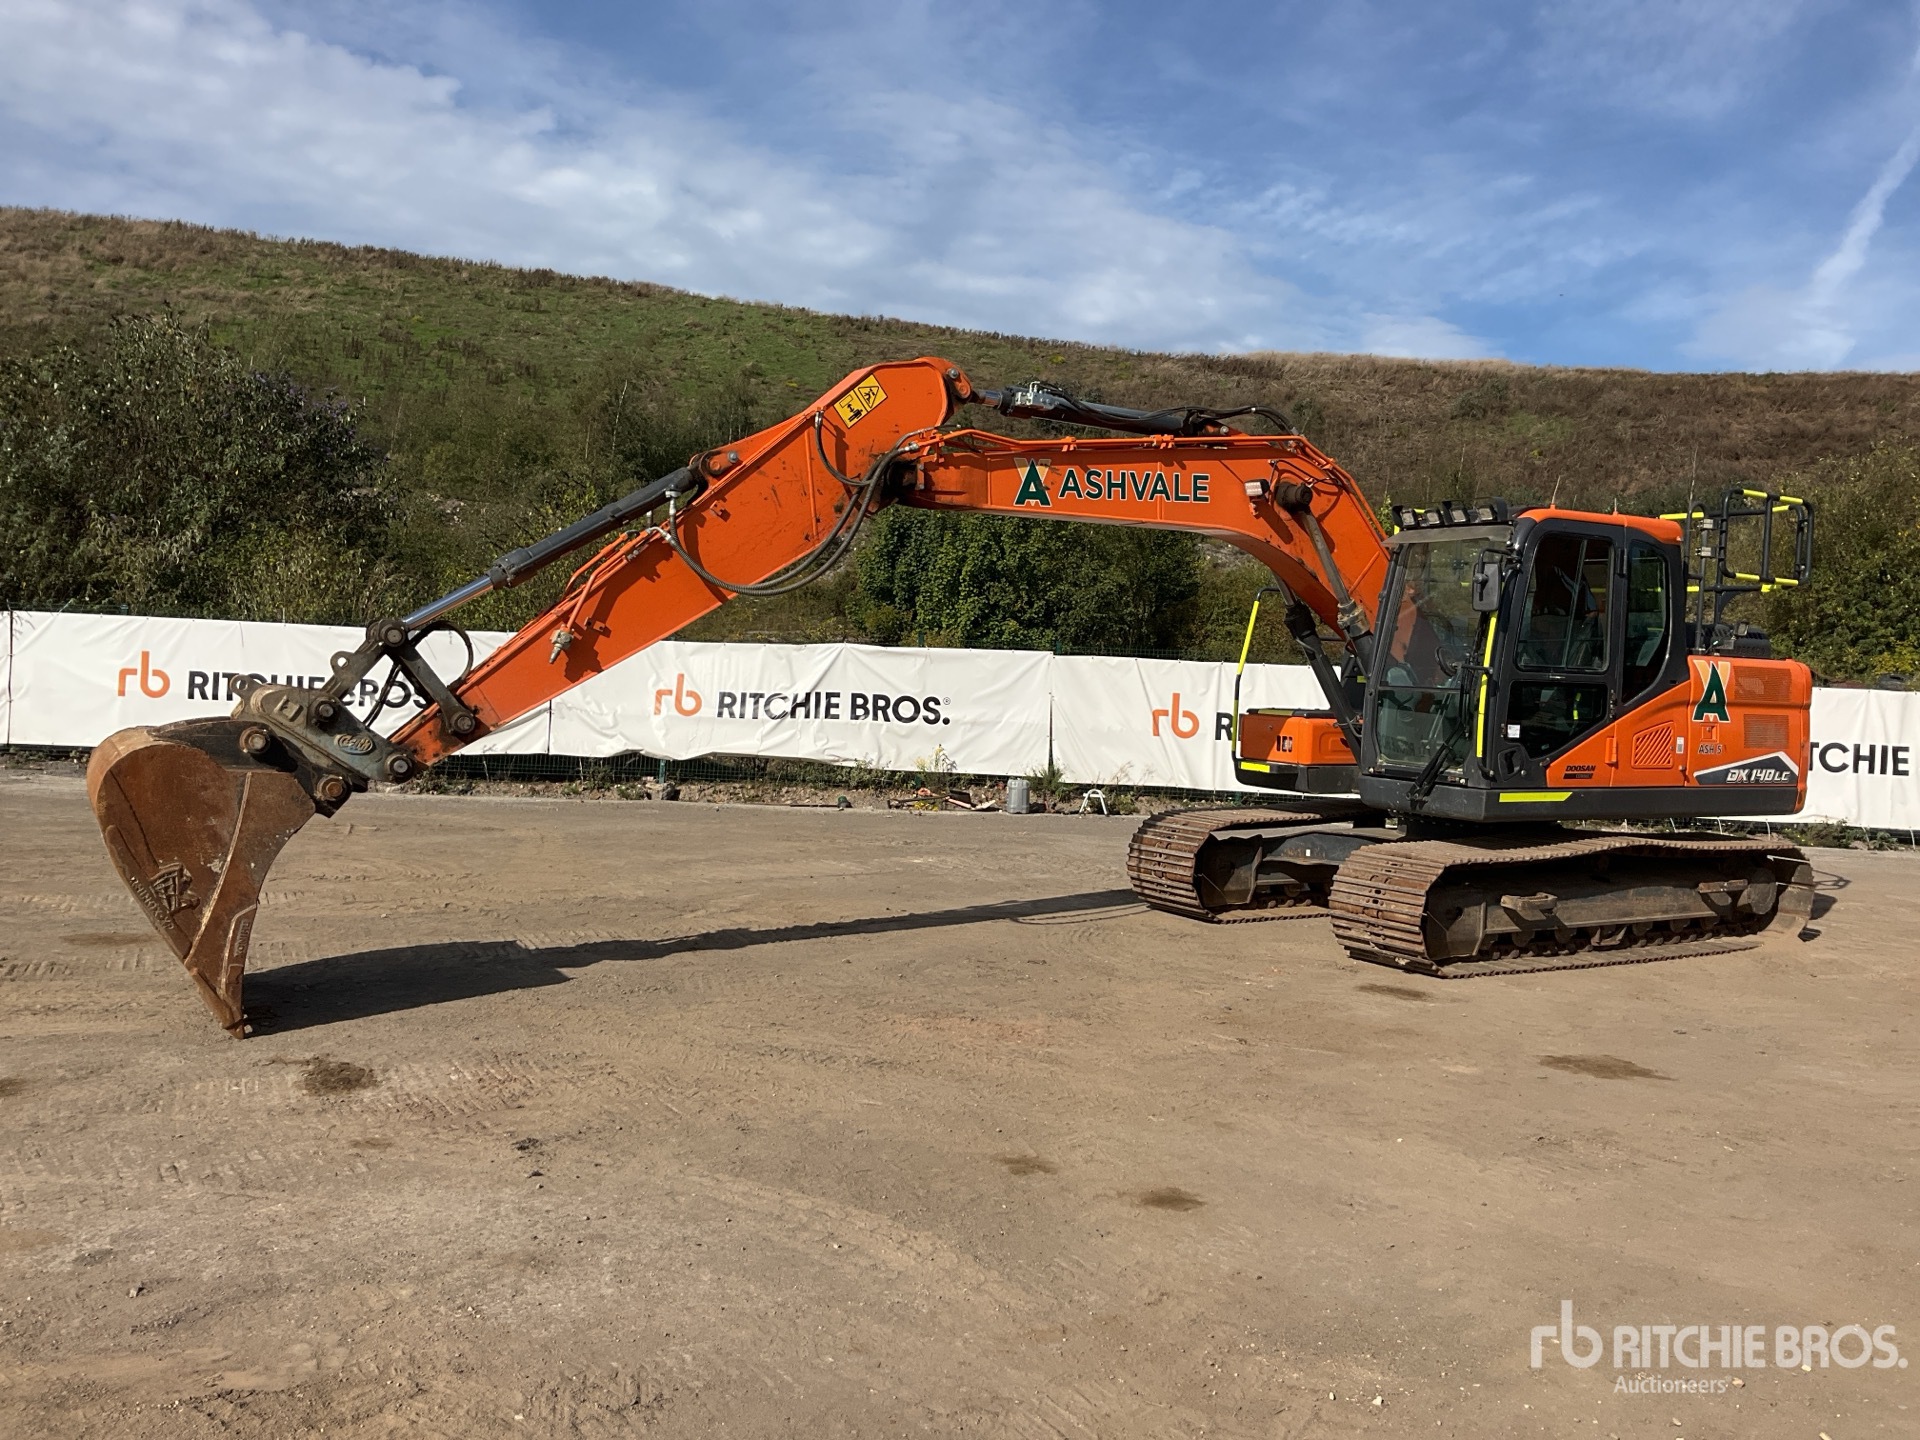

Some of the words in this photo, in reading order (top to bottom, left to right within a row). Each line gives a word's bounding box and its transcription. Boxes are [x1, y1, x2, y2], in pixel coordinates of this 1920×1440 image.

[1059, 468, 1210, 503] ASHVALE
[117, 650, 170, 698] rb
[654, 673, 702, 717] rb
[716, 691, 841, 720] RITCHIE
[850, 692, 950, 726] BROS.
[1152, 692, 1200, 739] rb
[1727, 768, 1750, 783] DX
[1809, 741, 1910, 776] TCHIE
